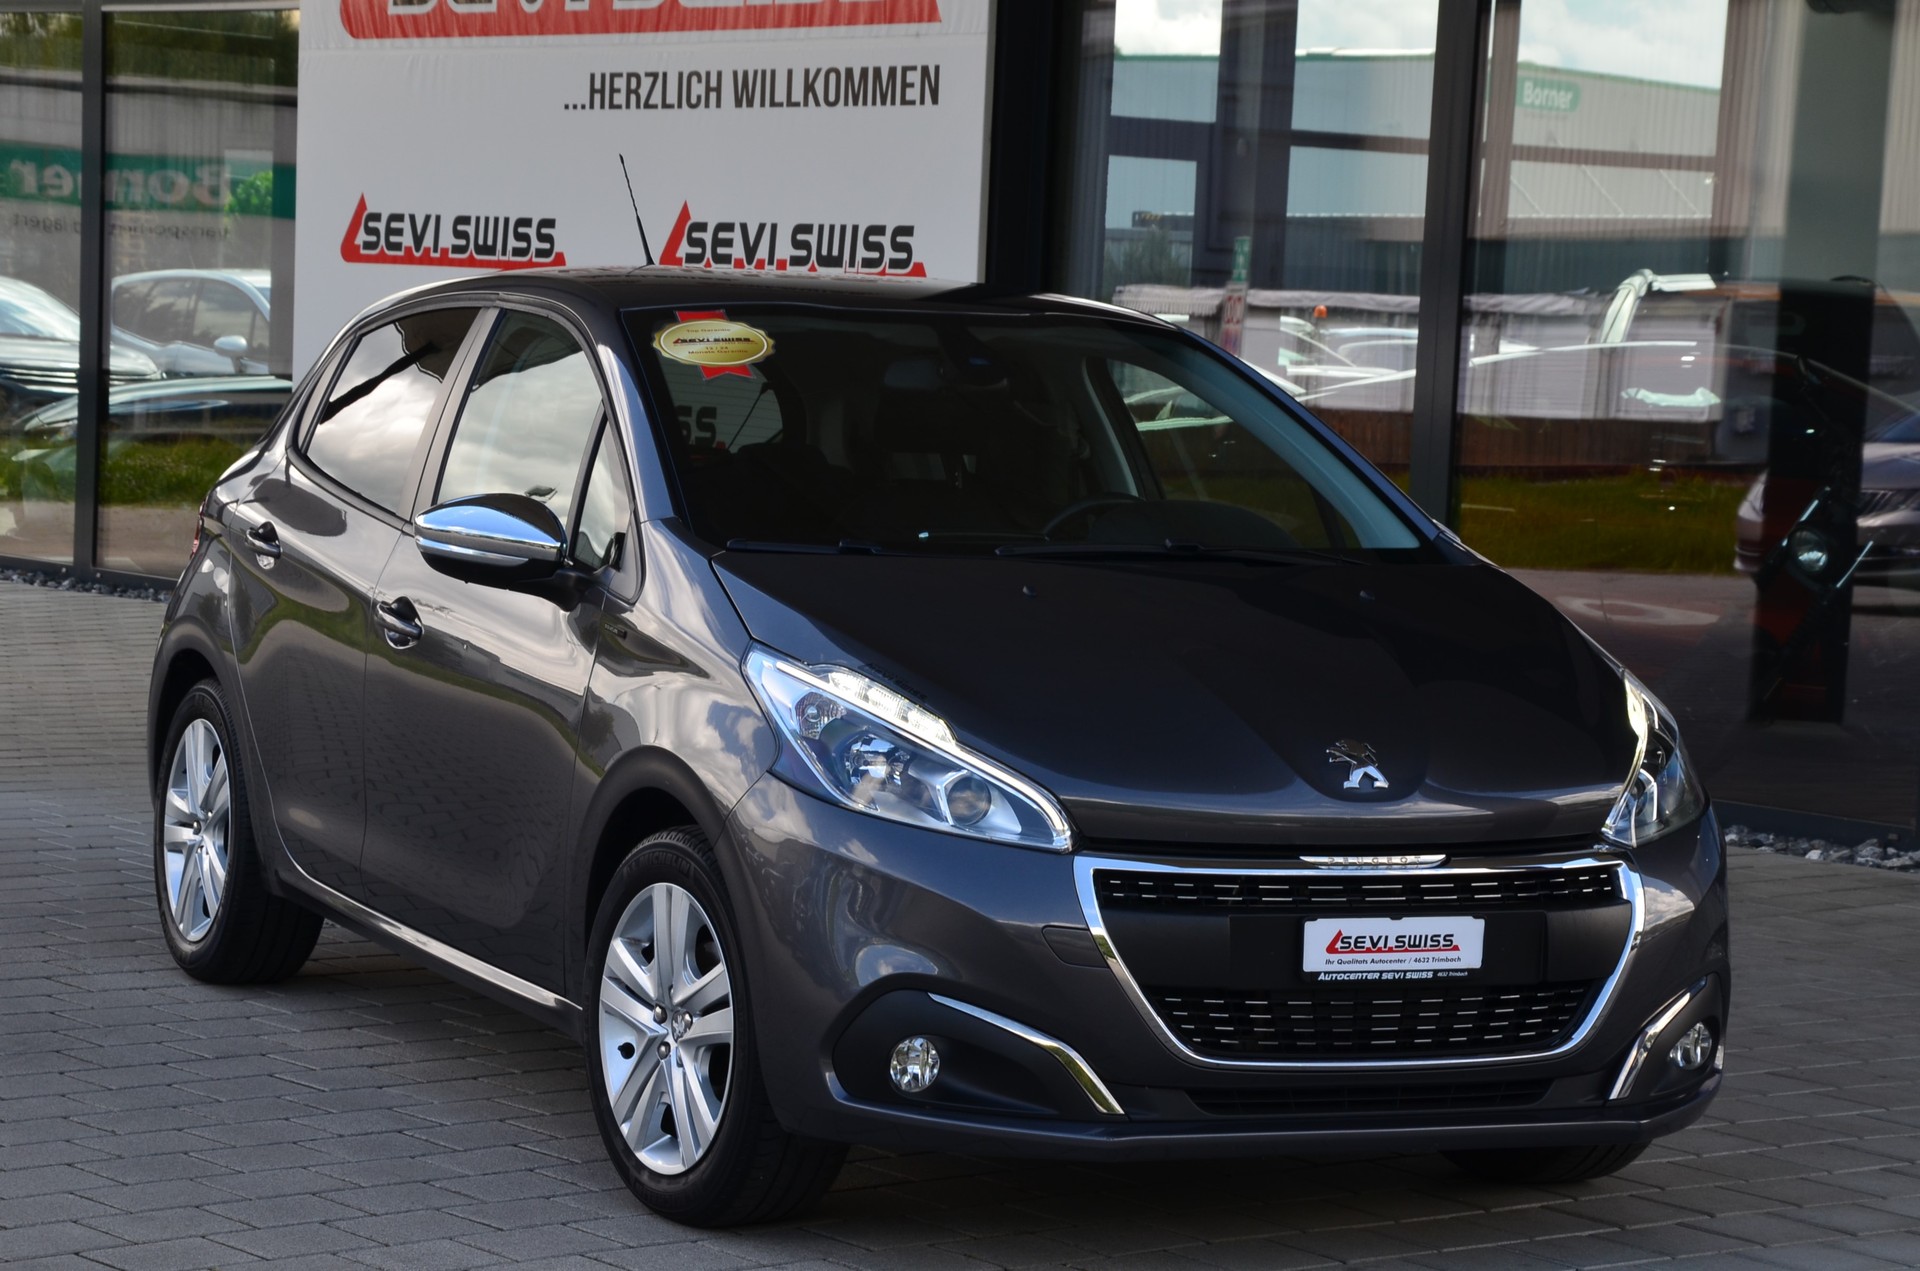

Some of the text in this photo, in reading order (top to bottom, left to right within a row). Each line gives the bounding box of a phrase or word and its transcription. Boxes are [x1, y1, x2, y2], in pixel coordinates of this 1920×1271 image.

[732, 65, 941, 108] WILLKOMMEN
[361, 212, 557, 259] SEVI SWISS
[684, 222, 915, 270] SEVI SWISS
[1328, 856, 1421, 864] PEUGEOT
[1339, 934, 1455, 950] SEVI SWISS
[1382, 972, 1404, 980] SEVI
[1406, 971, 1434, 979] SWISS
